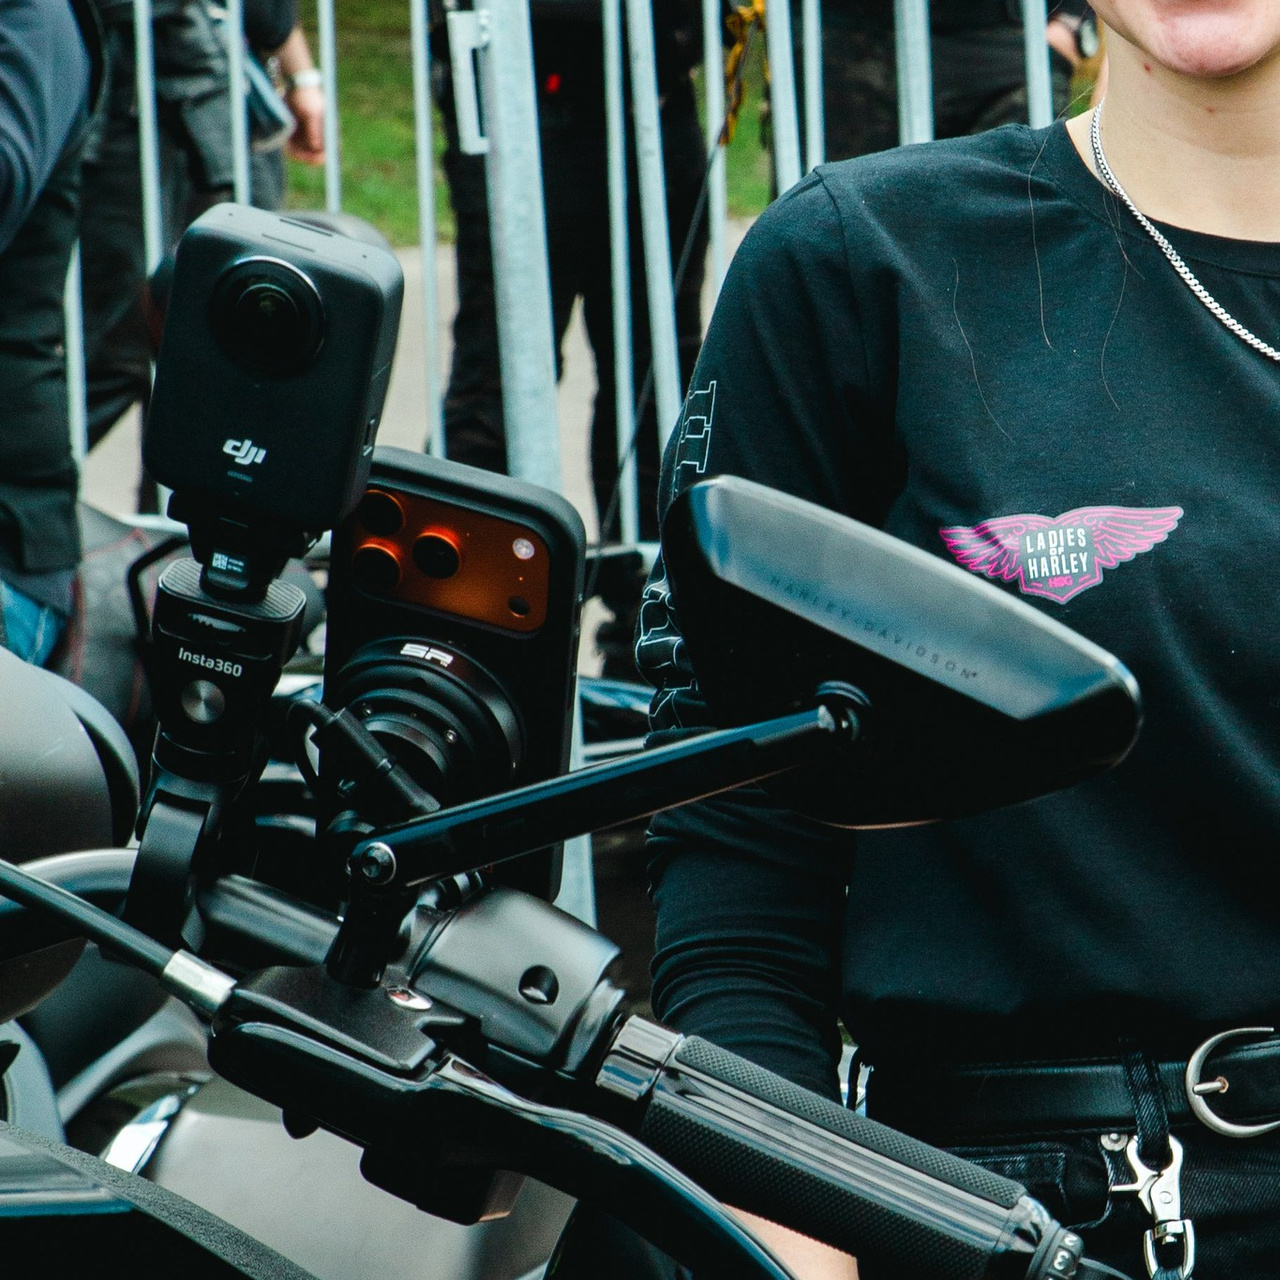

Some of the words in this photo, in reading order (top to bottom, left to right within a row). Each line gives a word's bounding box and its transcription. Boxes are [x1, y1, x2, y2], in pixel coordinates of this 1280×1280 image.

[1026, 528, 1087, 554] LADIES
[1049, 546, 1065, 556] OF
[1028, 552, 1088, 579] HARLEY
[178, 647, 243, 677] Insta360
